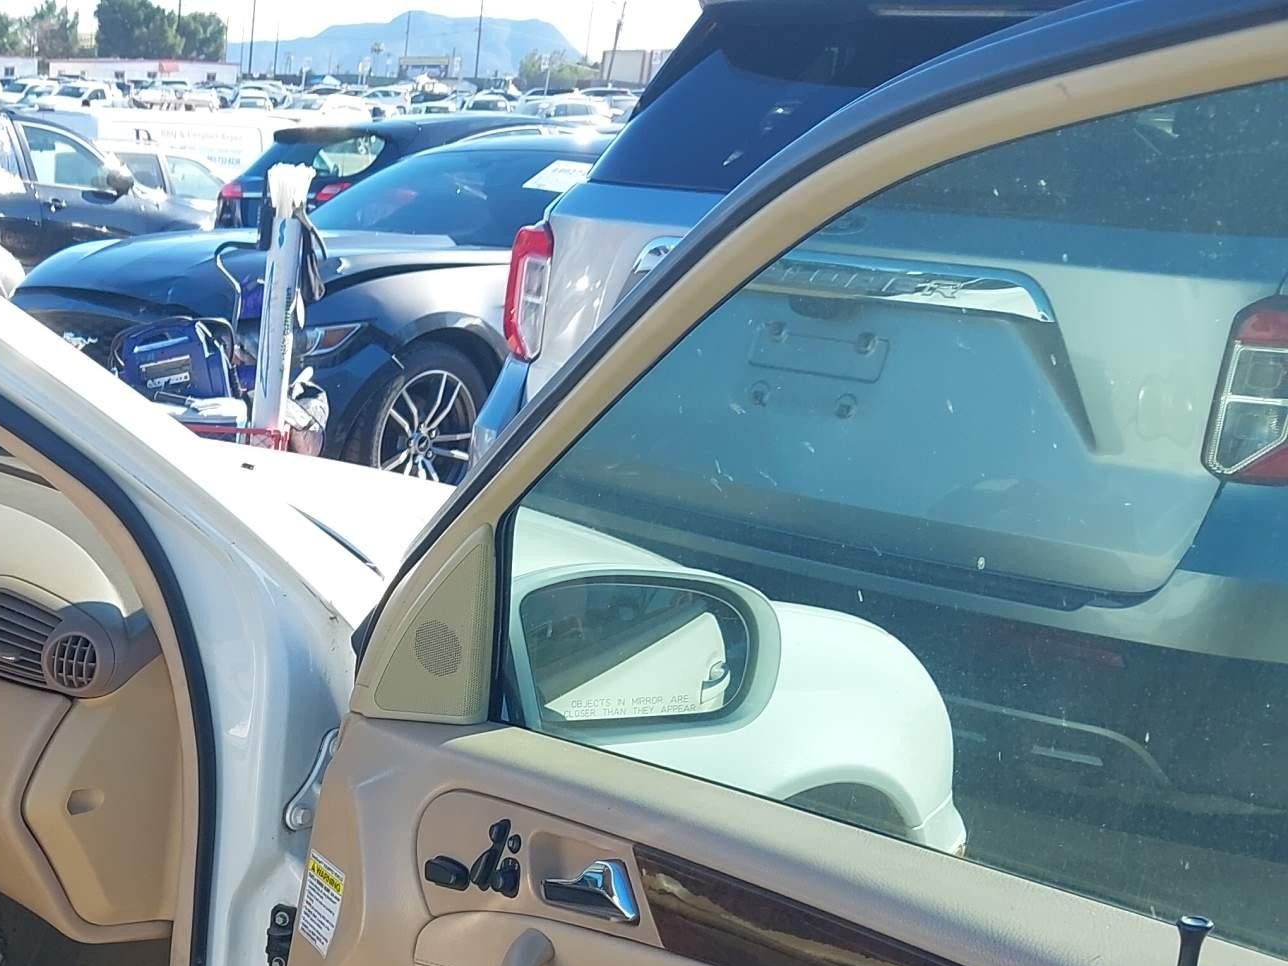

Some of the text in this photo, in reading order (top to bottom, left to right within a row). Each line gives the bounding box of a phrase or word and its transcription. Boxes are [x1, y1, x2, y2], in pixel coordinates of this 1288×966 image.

[571, 694, 689, 709] OBJECTS IN MIRROR ARE
[563, 703, 697, 718] CLOSER THAN THEY APPEAR
